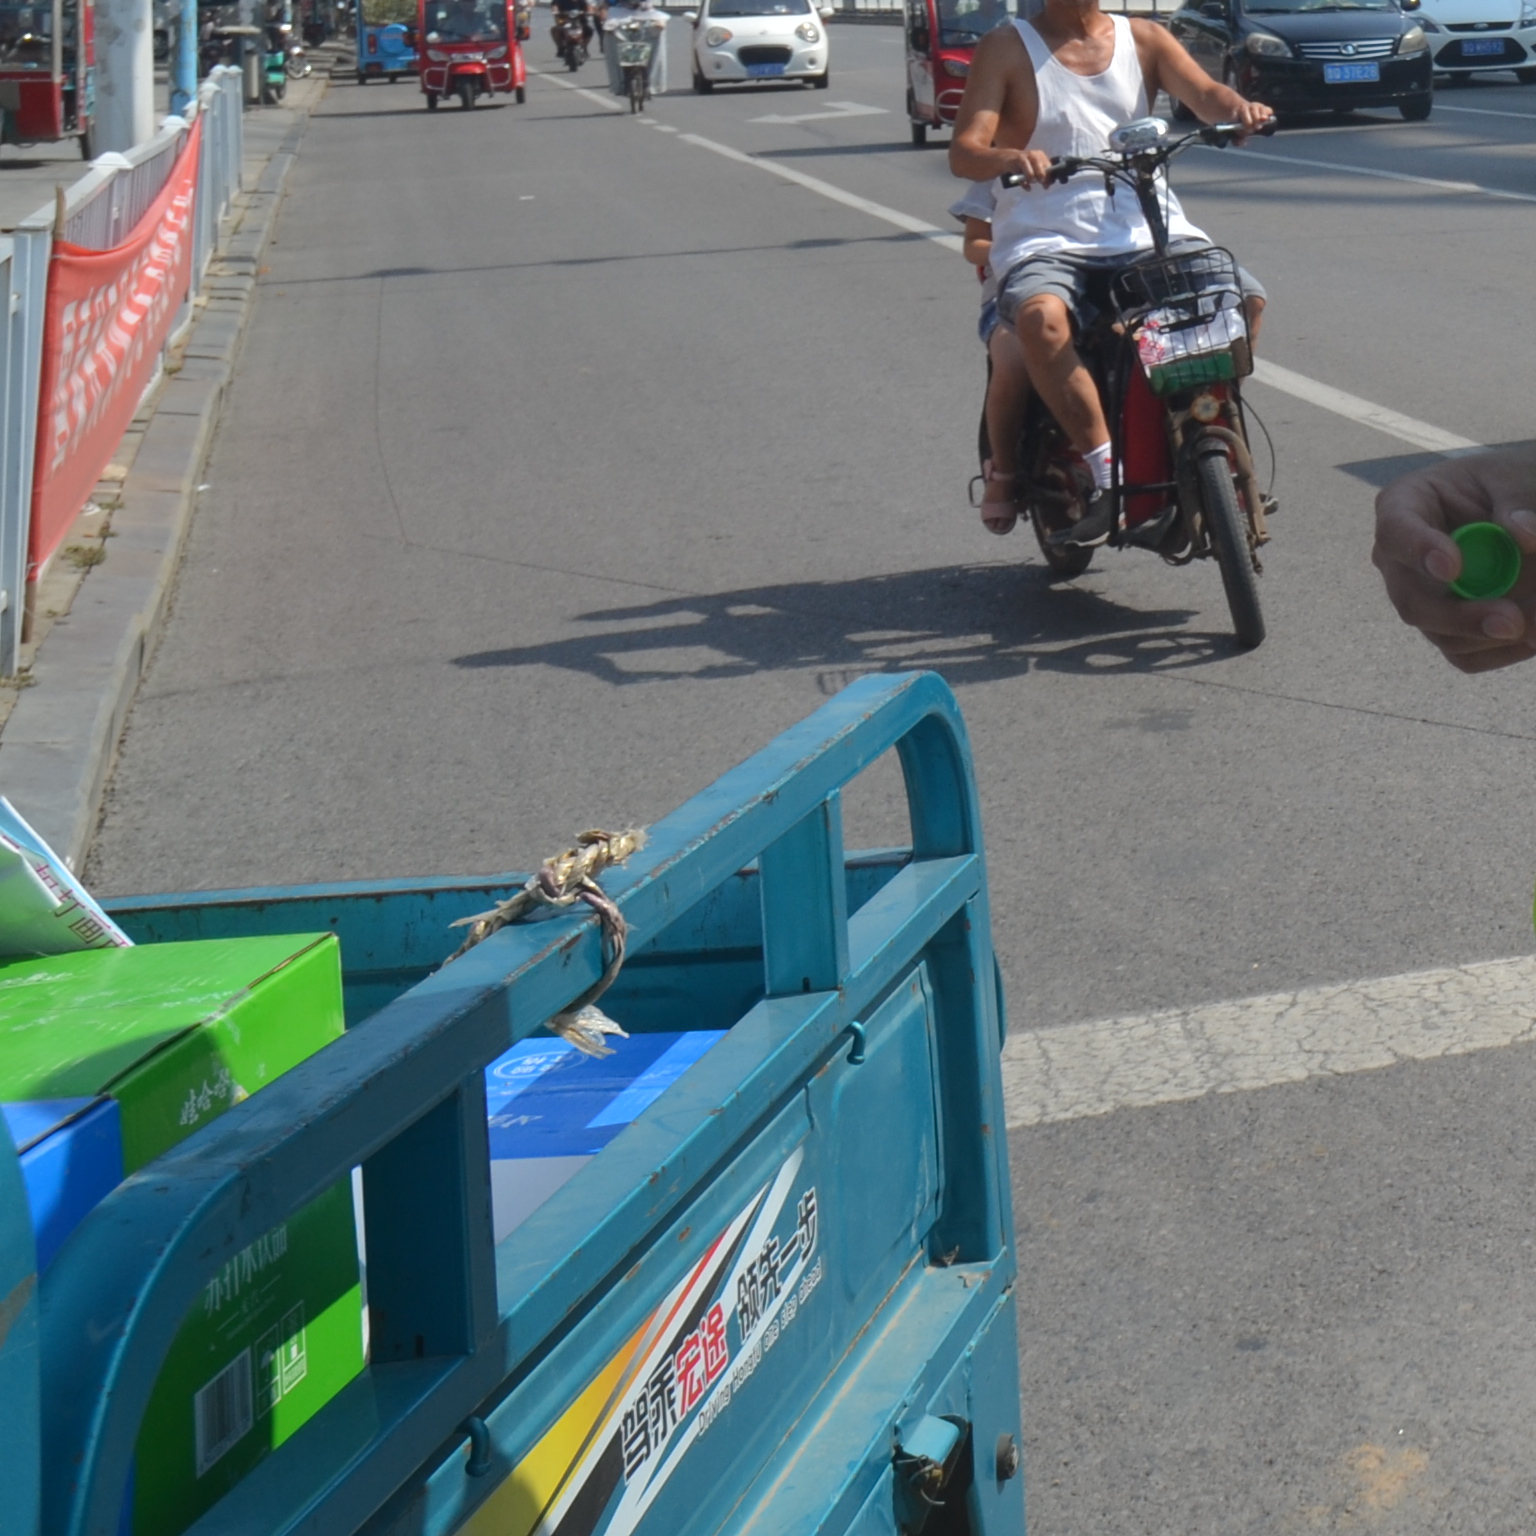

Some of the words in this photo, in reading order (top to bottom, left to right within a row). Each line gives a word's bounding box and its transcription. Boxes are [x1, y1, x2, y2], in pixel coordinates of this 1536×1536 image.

[179, 1067, 231, 1126] 娃哈哈
[620, 1300, 729, 1486] 驾乘宏途
[737, 1186, 816, 1346] 领先一步
[697, 1382, 731, 1437] Driving
